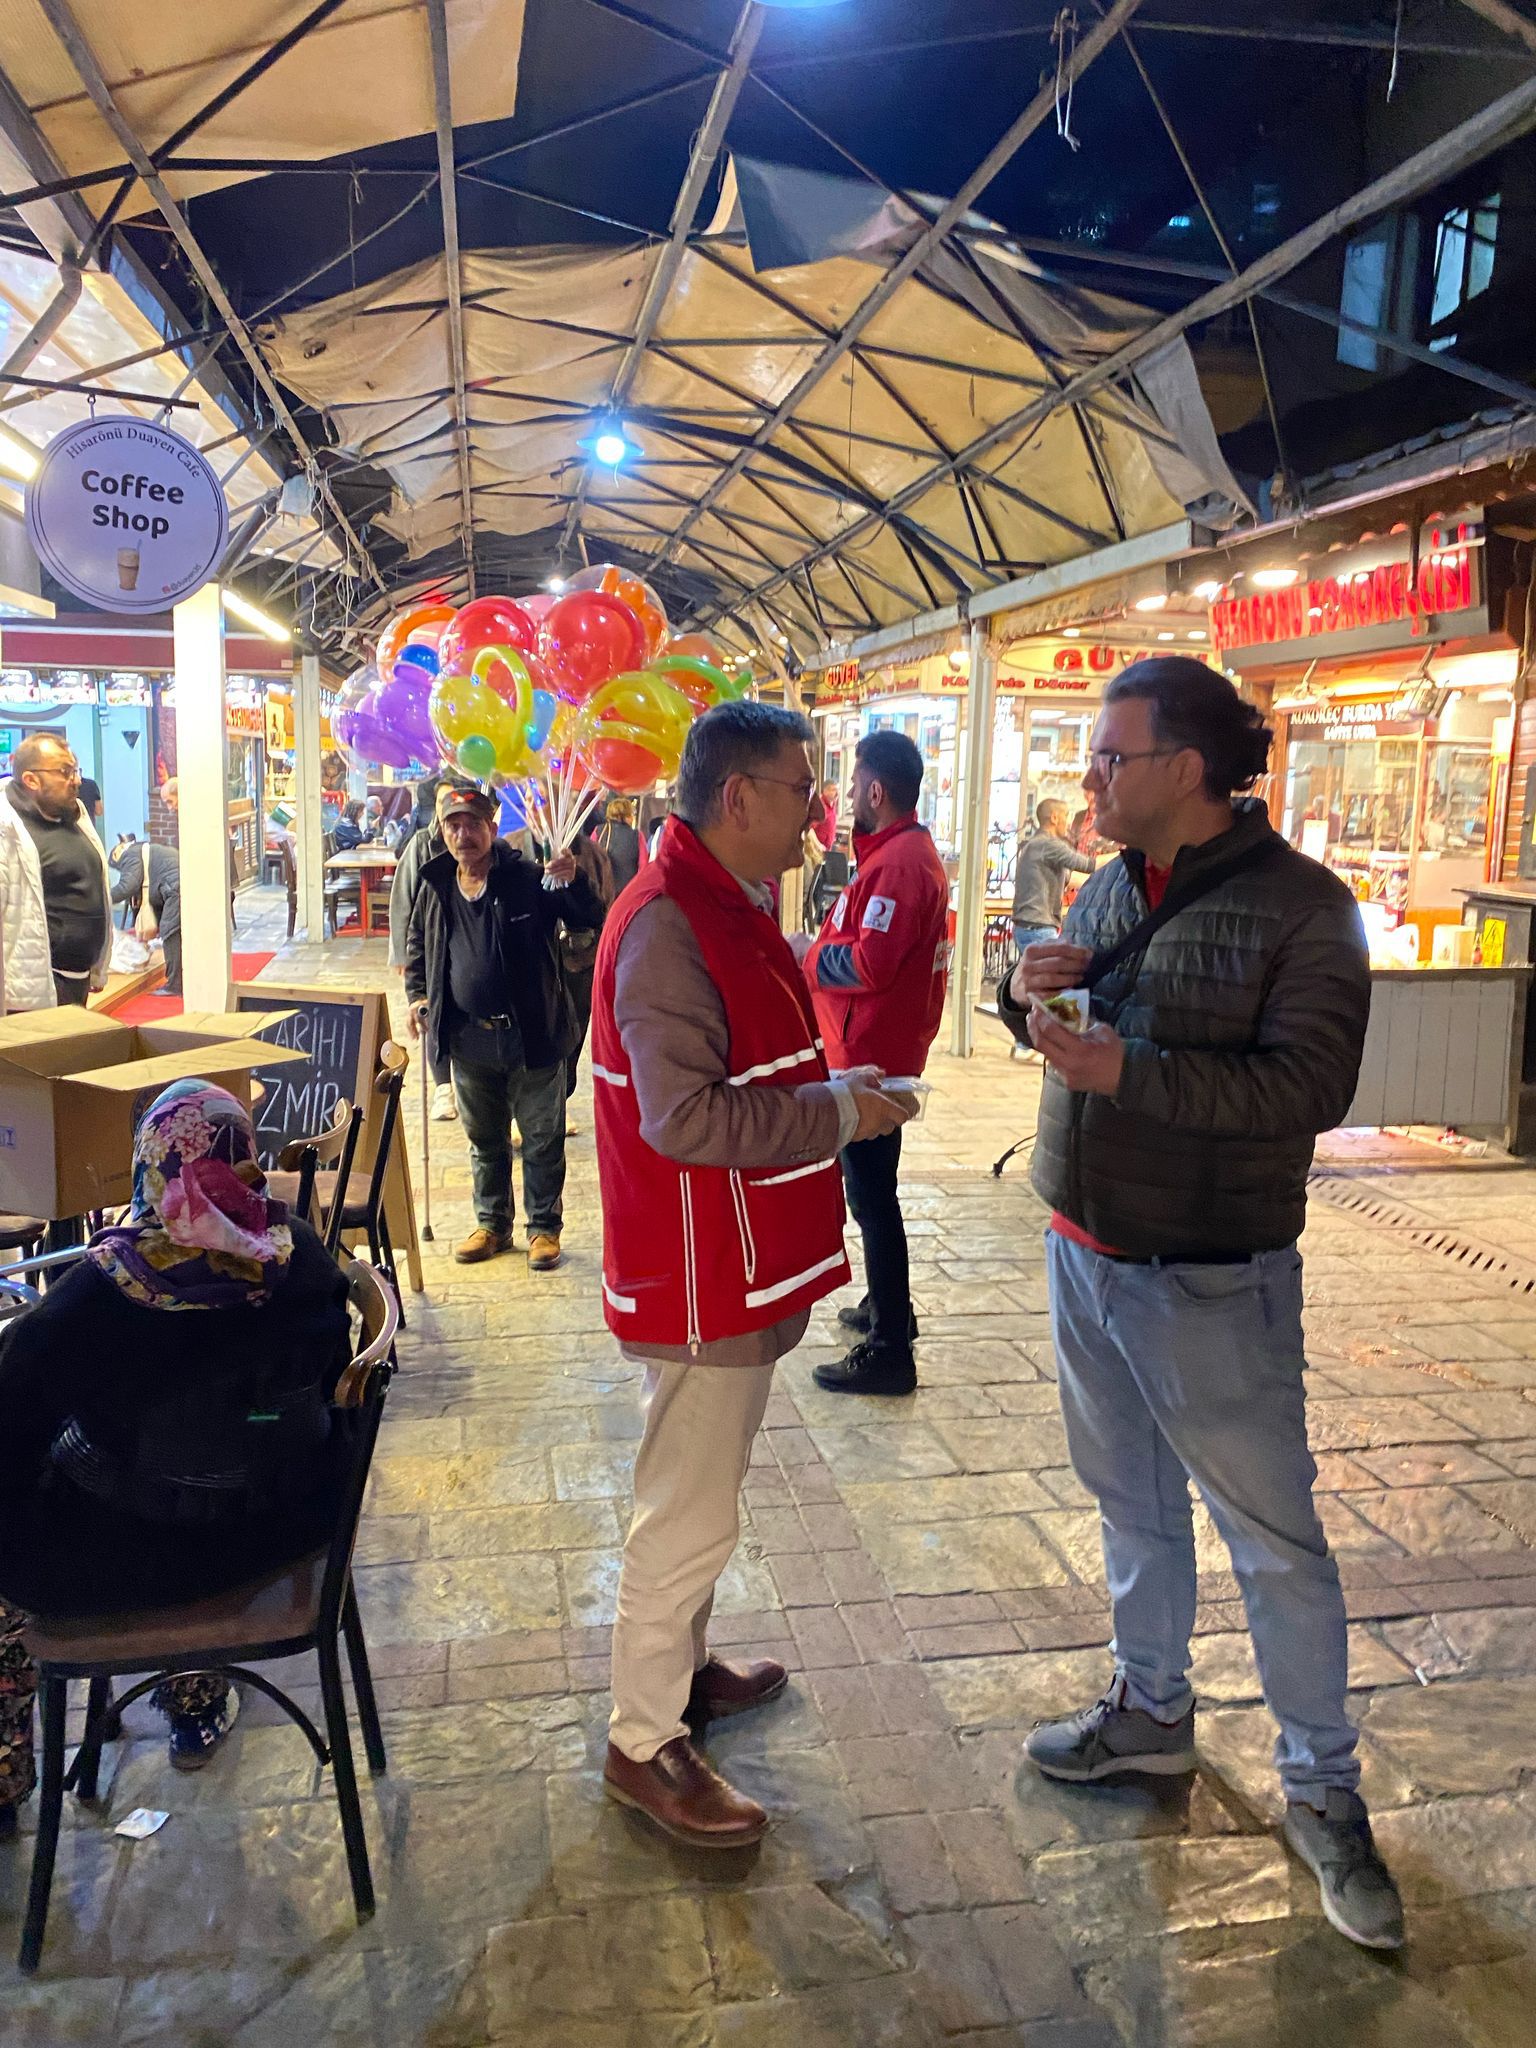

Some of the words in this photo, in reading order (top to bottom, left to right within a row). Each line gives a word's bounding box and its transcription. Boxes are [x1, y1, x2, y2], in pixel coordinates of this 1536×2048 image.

[65, 427, 123, 459] Hisarönü
[127, 427, 175, 455] Duayen
[177, 451, 200, 478] Cafe
[81, 470, 184, 505] Coffee
[92, 504, 169, 539] Shop
[1033, 678, 1090, 690] Döner
